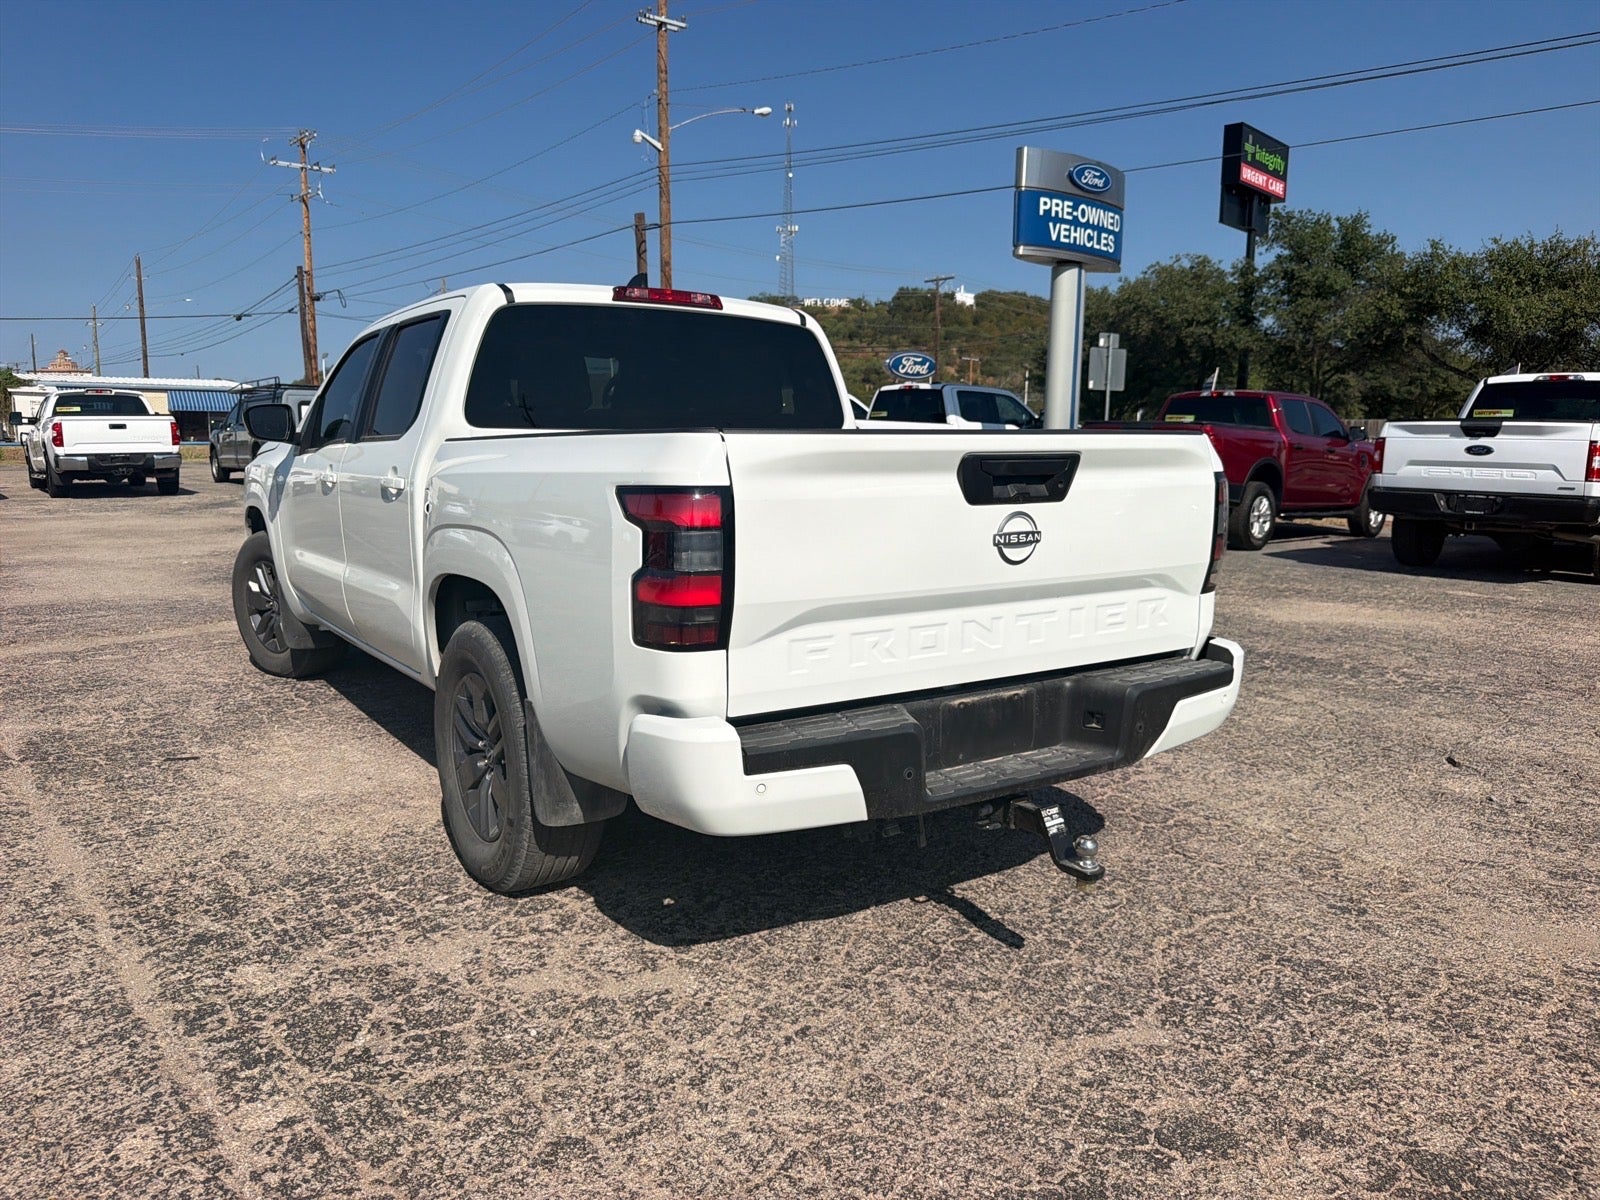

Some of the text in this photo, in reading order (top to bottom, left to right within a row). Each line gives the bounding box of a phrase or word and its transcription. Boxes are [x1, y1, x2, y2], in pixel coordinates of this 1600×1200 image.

[1255, 144, 1286, 175] Integrity
[1081, 169, 1105, 187] Ford
[1242, 166, 1285, 195] URGENT CARE
[1039, 197, 1121, 233] PRE-OWNED
[1049, 222, 1115, 253] VEHICLES
[803, 298, 850, 307] WELCOME
[899, 356, 929, 375] Ford
[995, 533, 1041, 543] NISSAN
[788, 597, 1169, 676] FRONTIER
